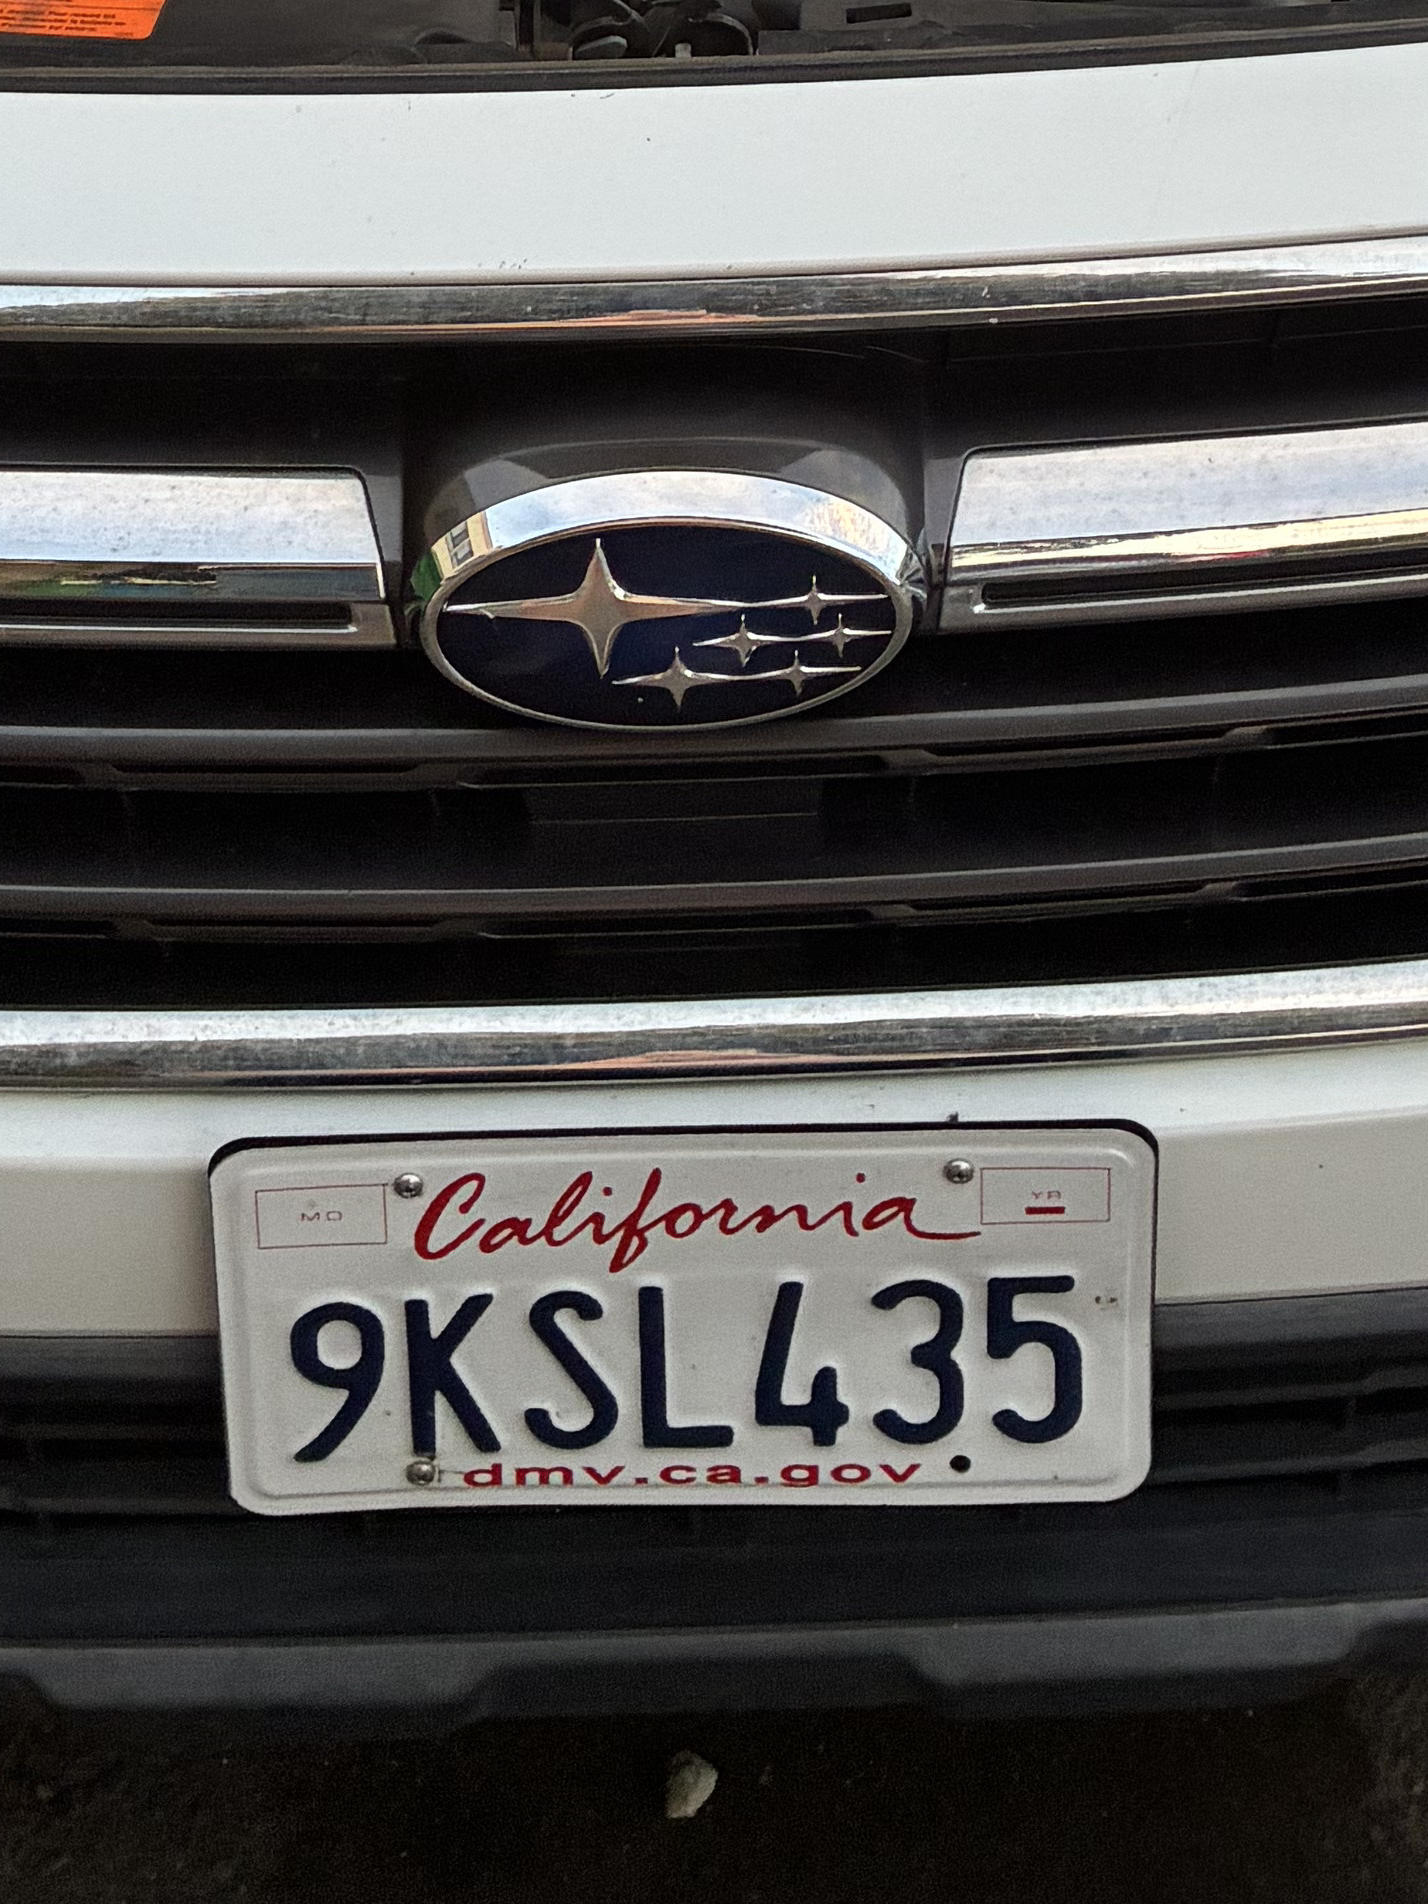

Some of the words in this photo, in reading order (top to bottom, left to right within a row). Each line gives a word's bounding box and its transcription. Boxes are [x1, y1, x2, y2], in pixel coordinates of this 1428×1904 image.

[1031, 1190, 1062, 1200] YR
[300, 1210, 343, 1222] MO
[414, 1168, 981, 1273] California
[290, 1275, 1083, 1464] 9KSL435
[464, 1461, 920, 1489] dmv.ca.gov
